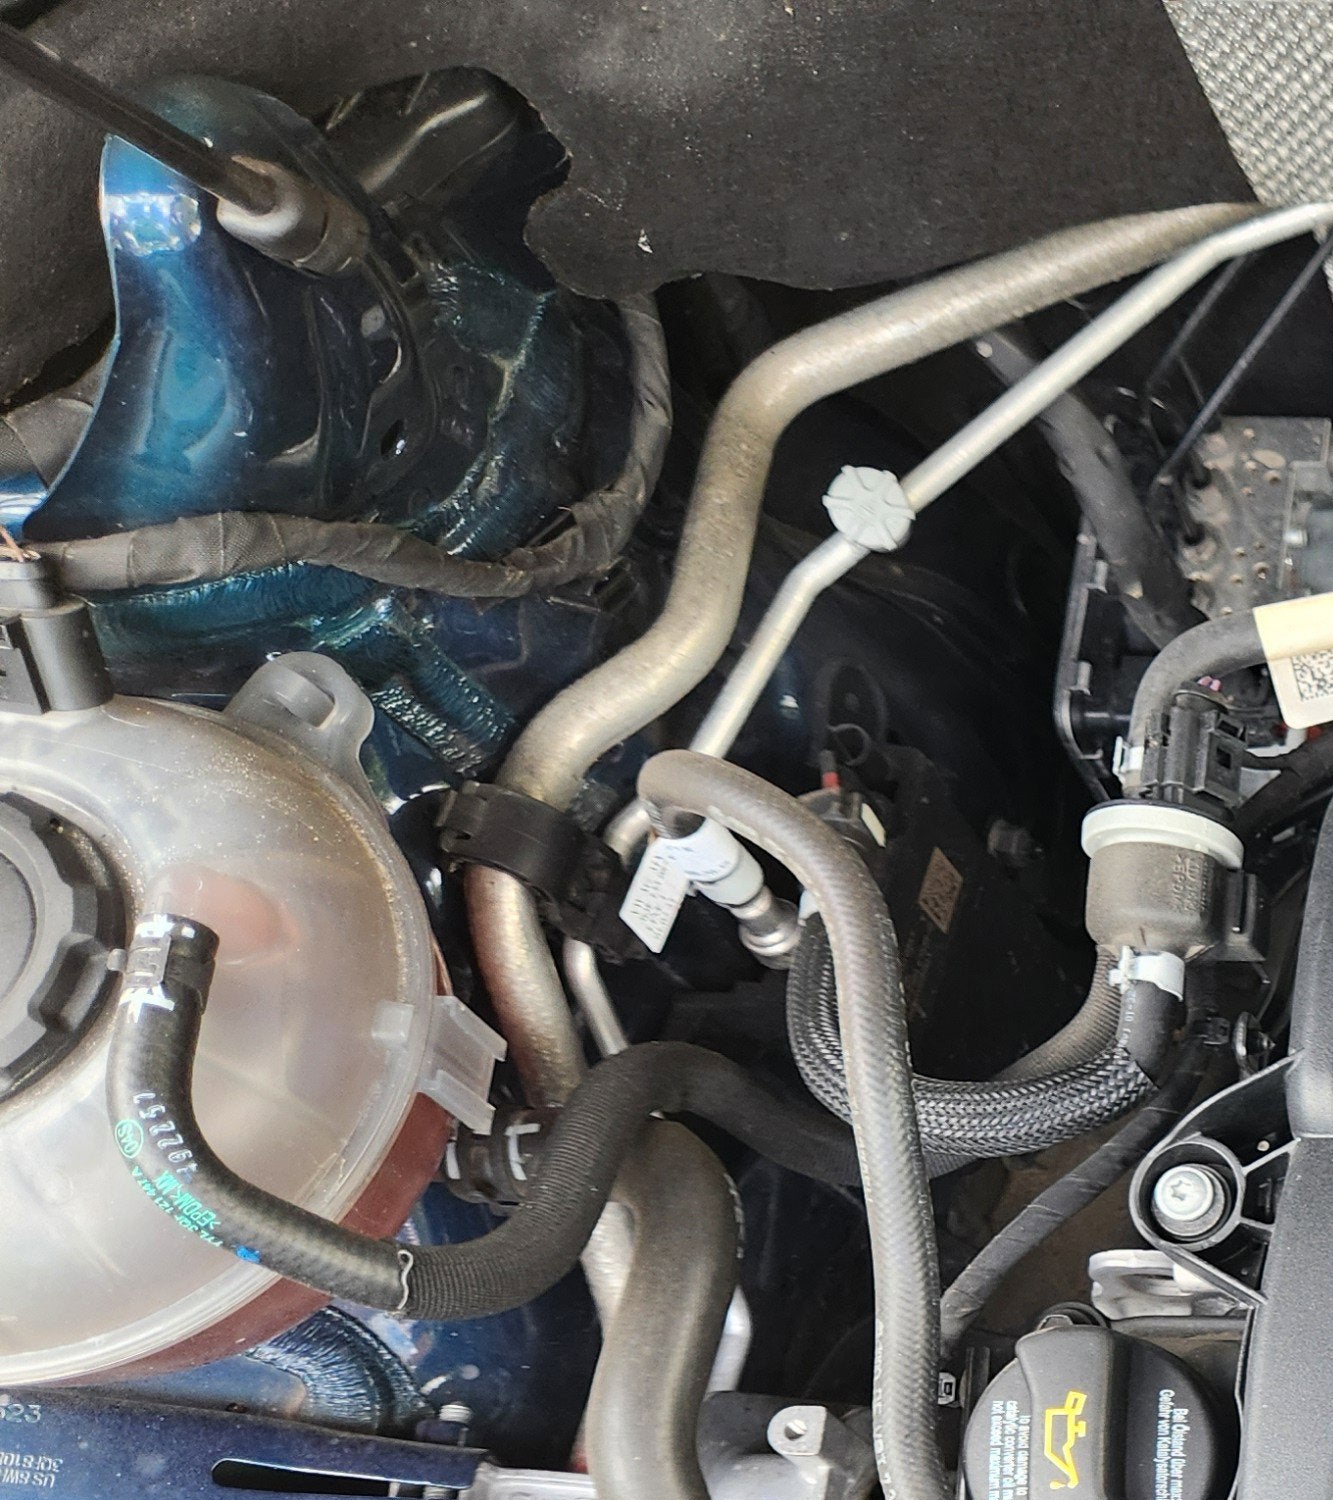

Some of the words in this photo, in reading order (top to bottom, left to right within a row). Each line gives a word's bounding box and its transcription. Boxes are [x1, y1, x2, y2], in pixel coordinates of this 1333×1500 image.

[131, 1165, 143, 1177] A
[991, 1400, 1005, 1415] not
[1158, 1389, 1176, 1419] Gefahr
[1002, 1400, 1020, 1435] catalytic
[1172, 1408, 1189, 1423] Bei
[990, 1415, 1004, 1447] exceed
[1017, 1425, 1031, 1449] avoid
[1158, 1419, 1172, 1436] von
[1171, 1424, 1191, 1457] Ölstand
[1003, 1435, 1016, 1477] converter
[989, 1447, 1003, 1490] maximum
[1014, 1450, 1030, 1486] damage
[1171, 1458, 1187, 1479] über
[31, 1472, 56, 1489] US
[1003, 1477, 1017, 1488] oil
[1016, 1487, 1029, 1496] to
